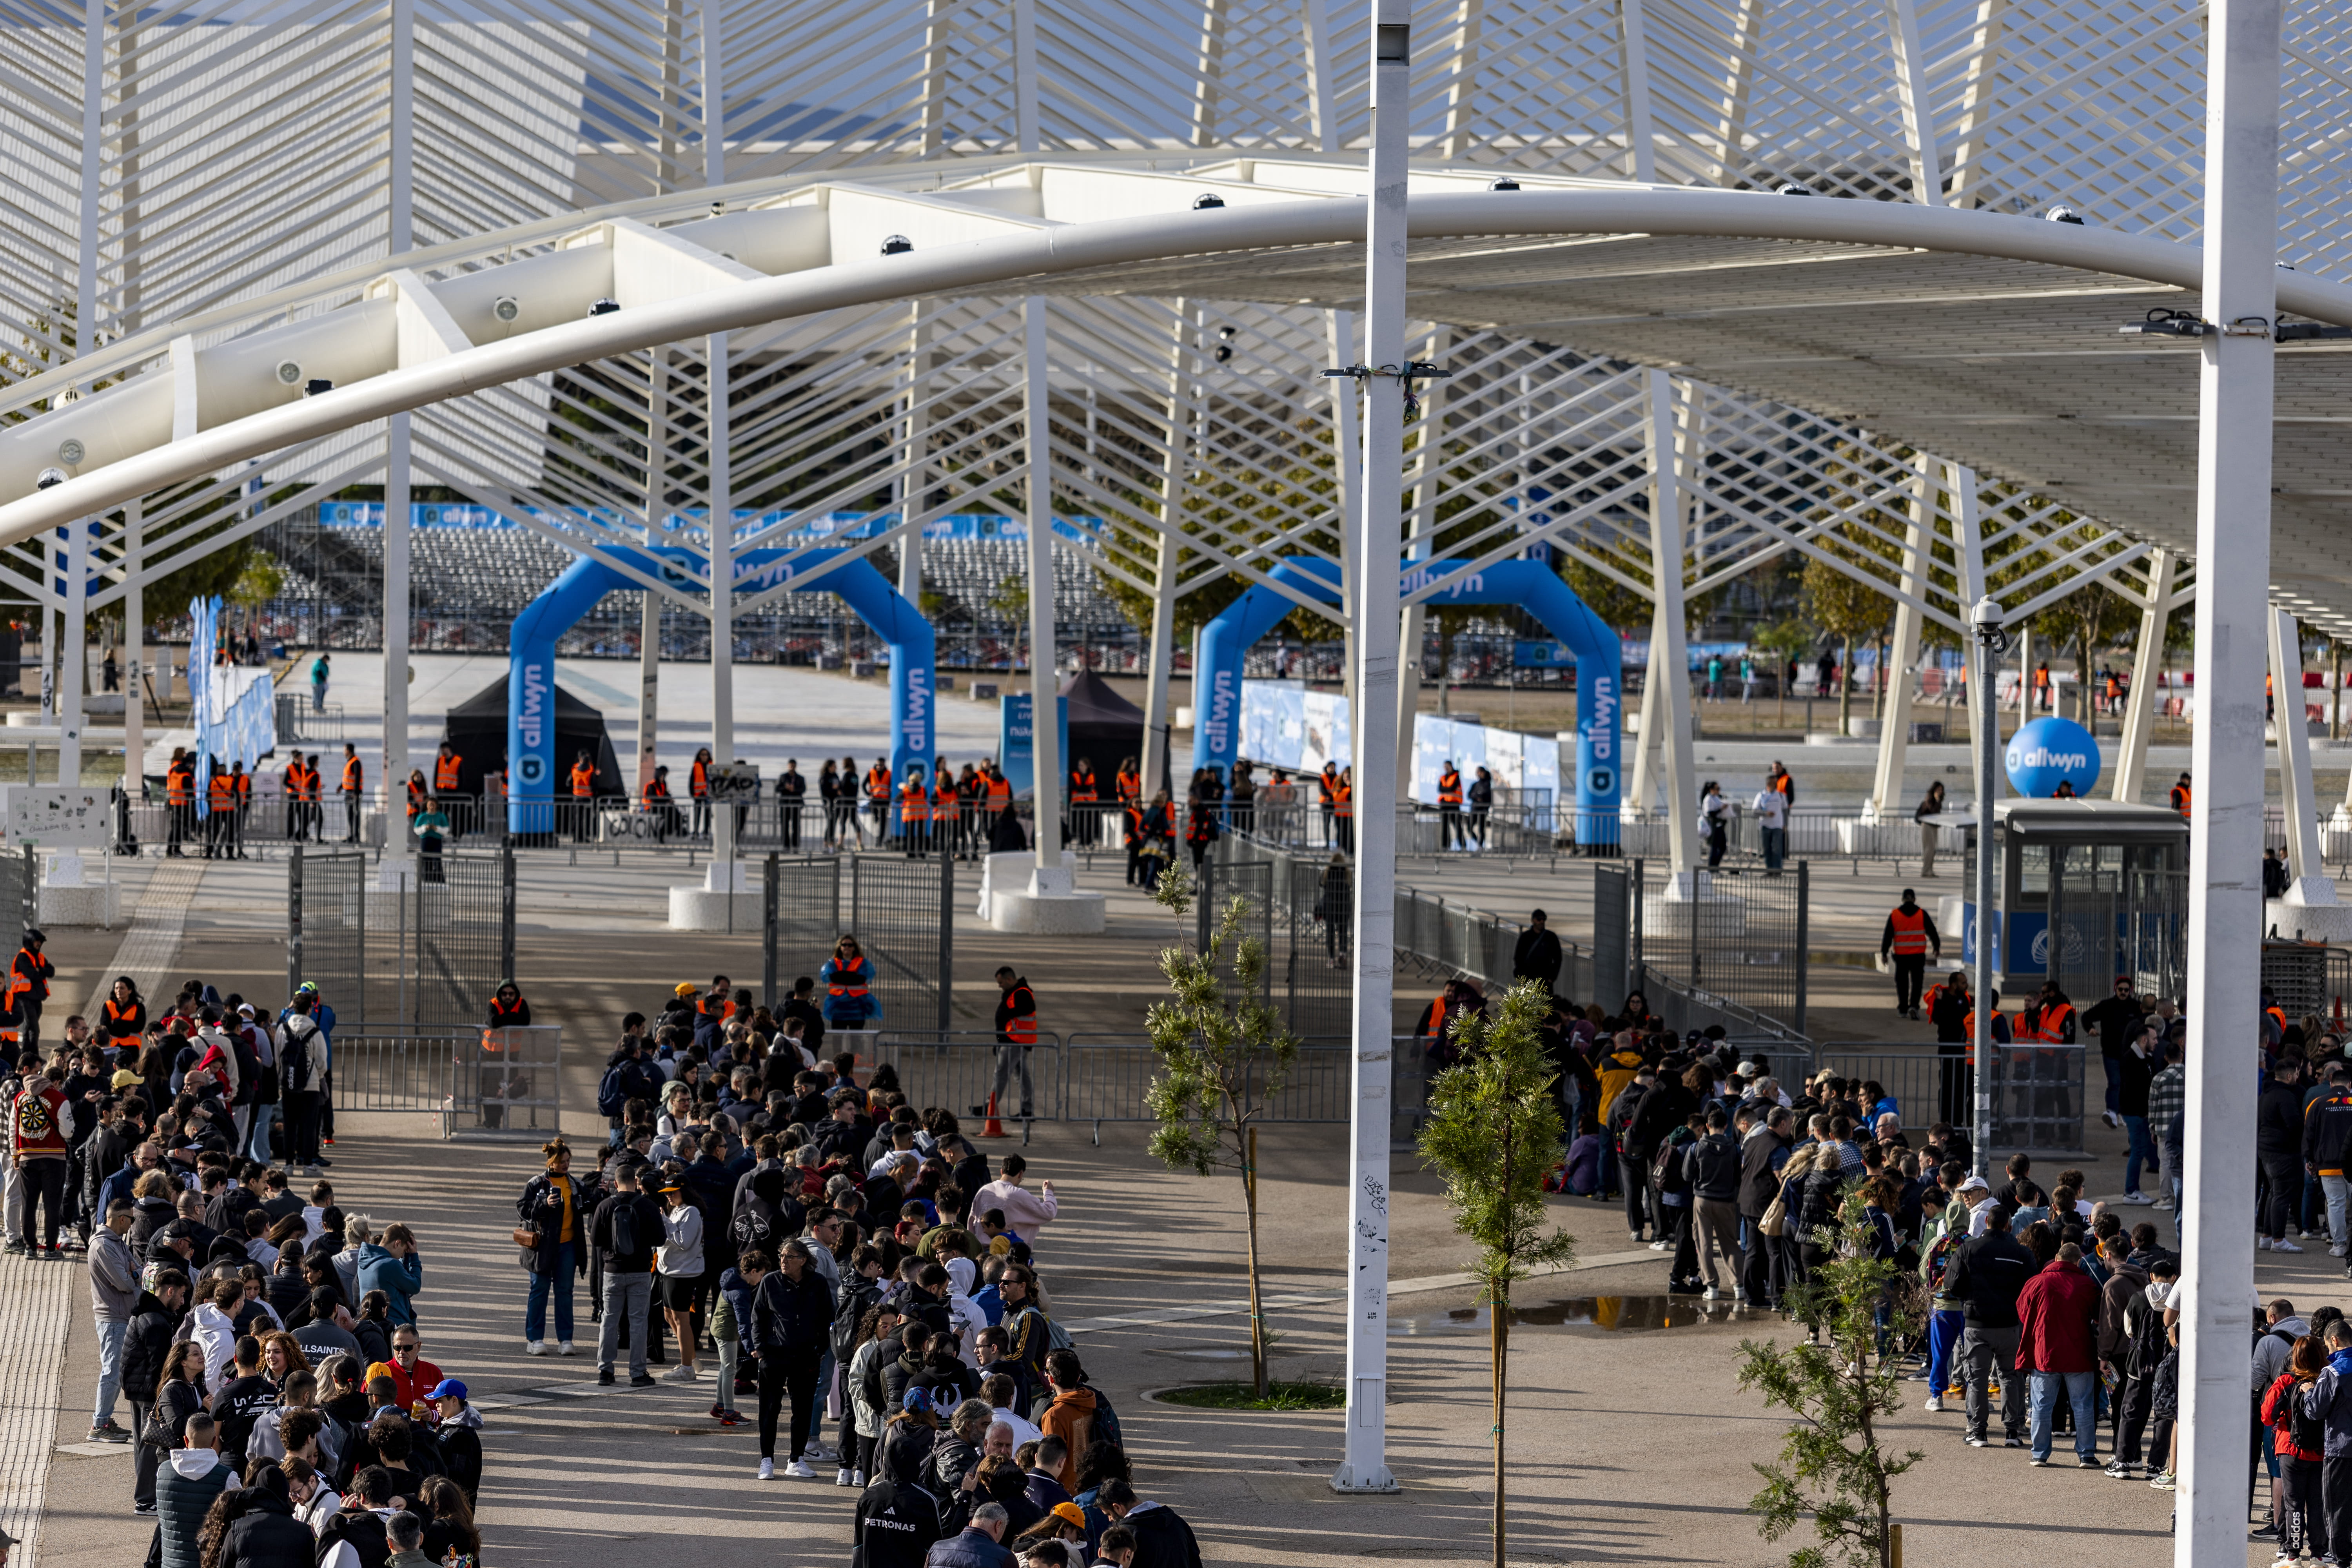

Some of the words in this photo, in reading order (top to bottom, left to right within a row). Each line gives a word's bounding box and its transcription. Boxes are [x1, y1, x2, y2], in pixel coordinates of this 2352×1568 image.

[517, 664, 548, 748] allwyn
[902, 668, 931, 751] allwyn
[1204, 670, 1236, 753] allwyn
[1588, 676, 1617, 760] allwyn
[2024, 747, 2087, 773] allwyn
[300, 1344, 345, 1355] LLSAINTS
[864, 1517, 916, 1532] PETRONAS
[2290, 1511, 2301, 1549] adidas
